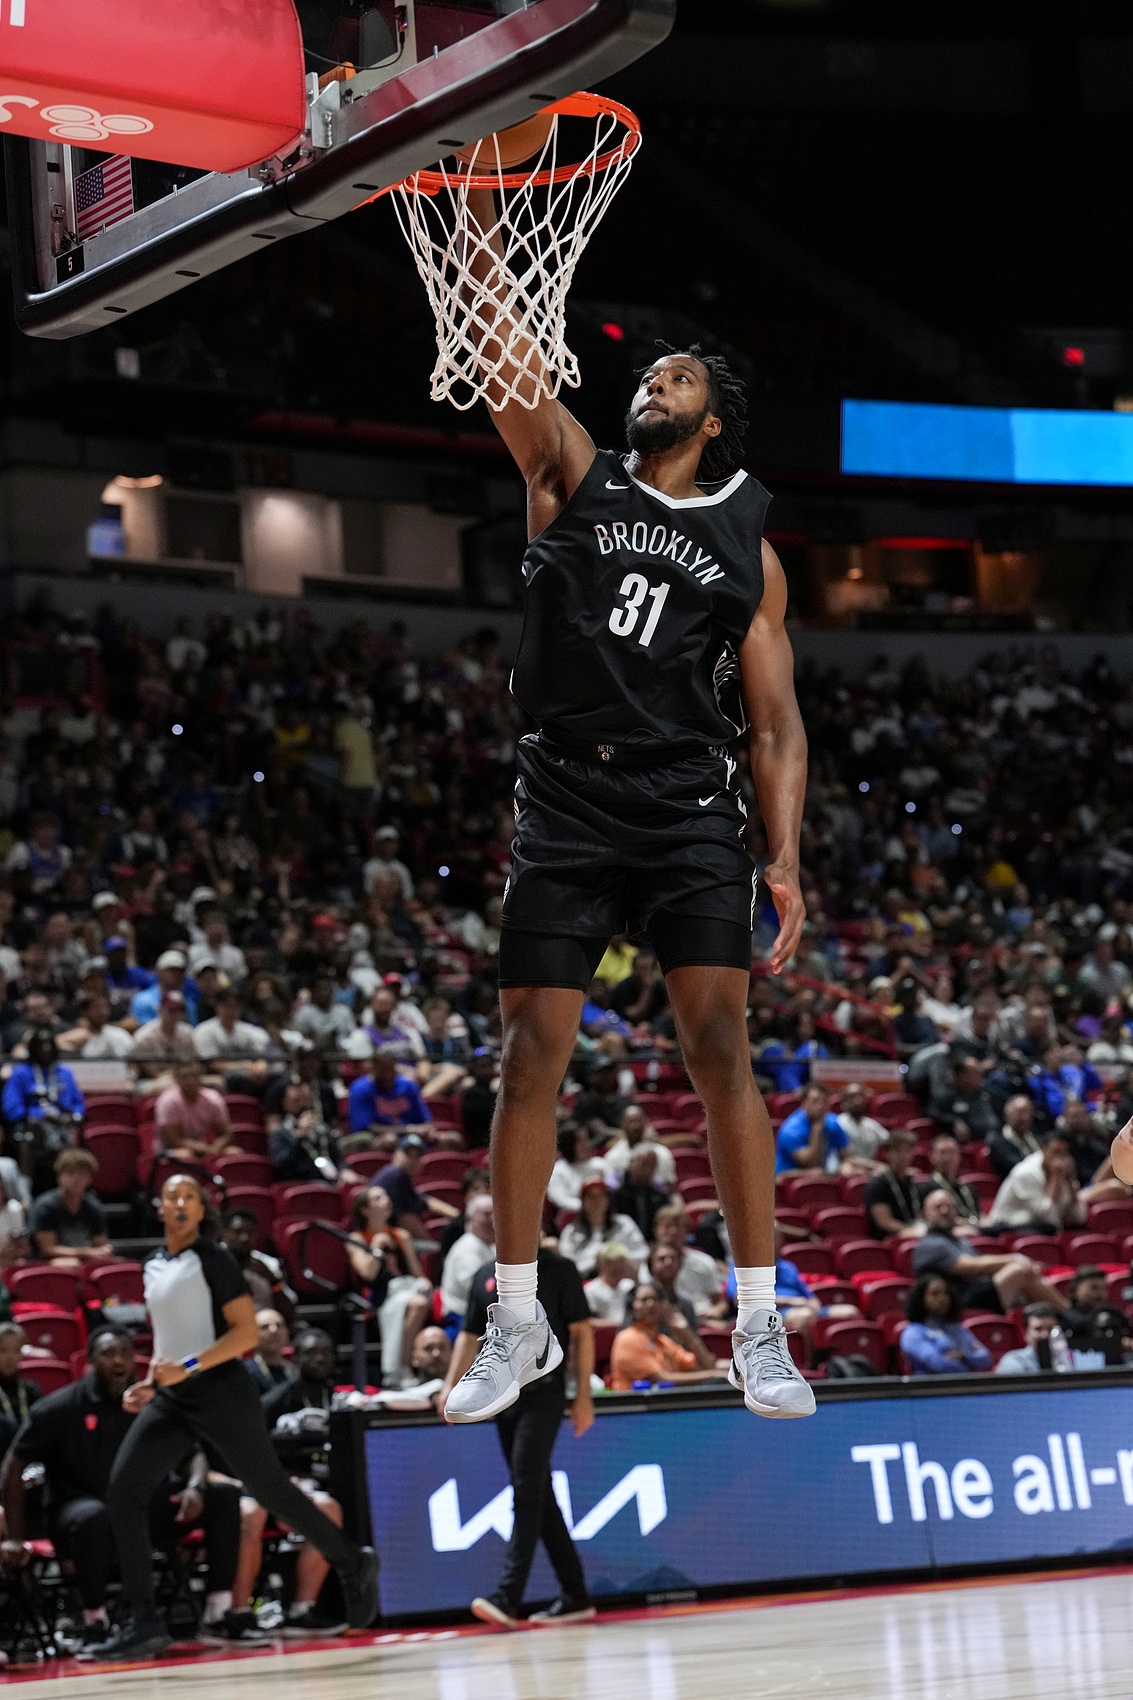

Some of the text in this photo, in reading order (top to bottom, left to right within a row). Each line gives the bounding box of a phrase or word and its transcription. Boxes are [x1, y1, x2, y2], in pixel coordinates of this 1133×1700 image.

[67, 256, 73, 272] 5
[593, 521, 726, 586] BROOKLYN
[608, 572, 671, 648] 31
[597, 745, 614, 754] NETS
[850, 1441, 994, 1524] The
